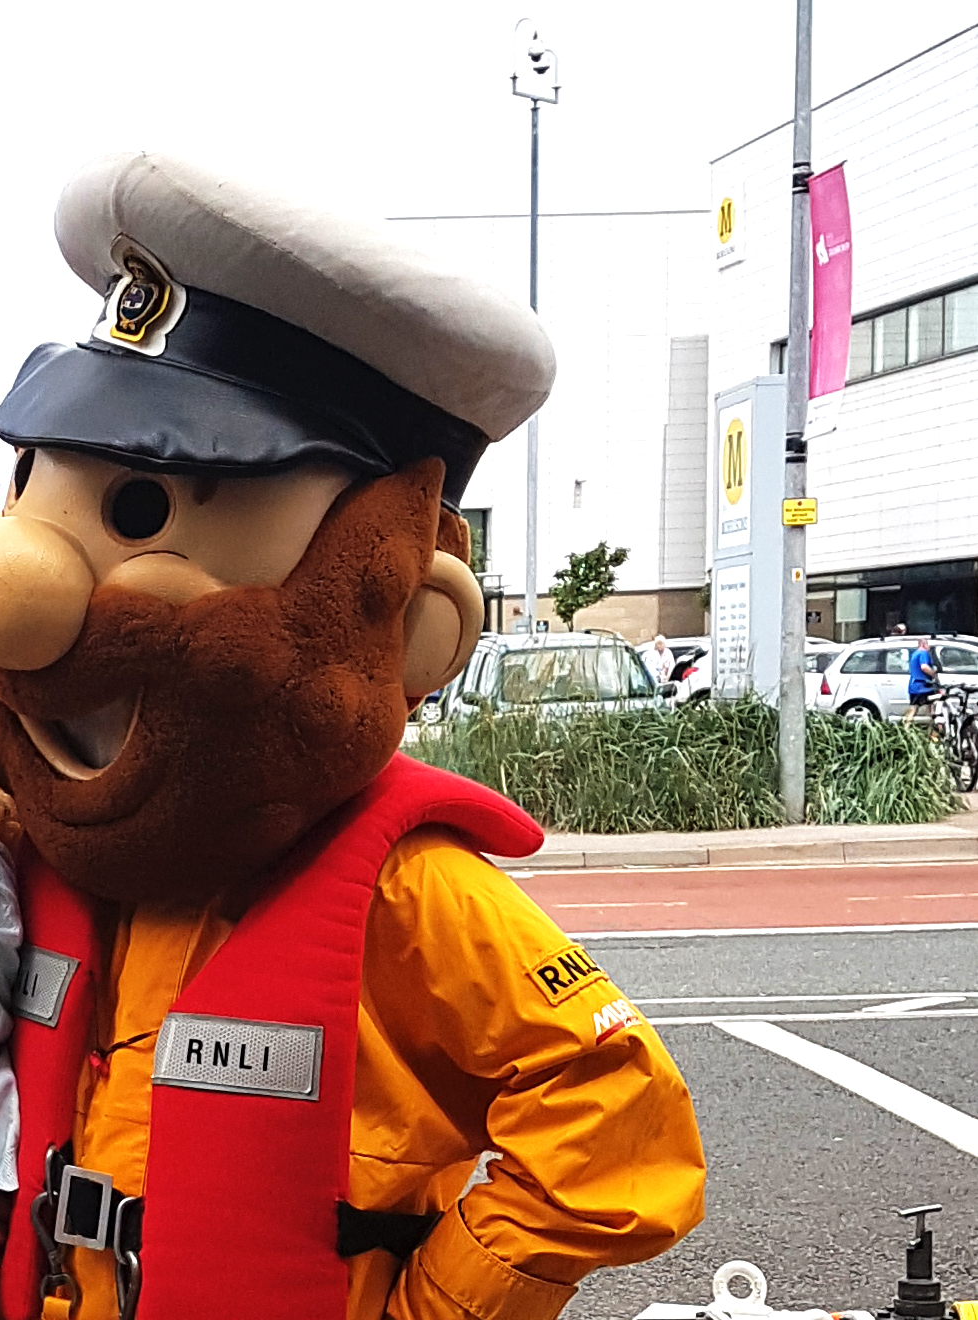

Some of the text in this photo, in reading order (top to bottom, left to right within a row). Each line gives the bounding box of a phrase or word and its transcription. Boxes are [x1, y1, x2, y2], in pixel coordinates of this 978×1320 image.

[720, 202, 732, 236] M
[726, 431, 743, 489] M
[186, 1039, 270, 1072] RNLI
